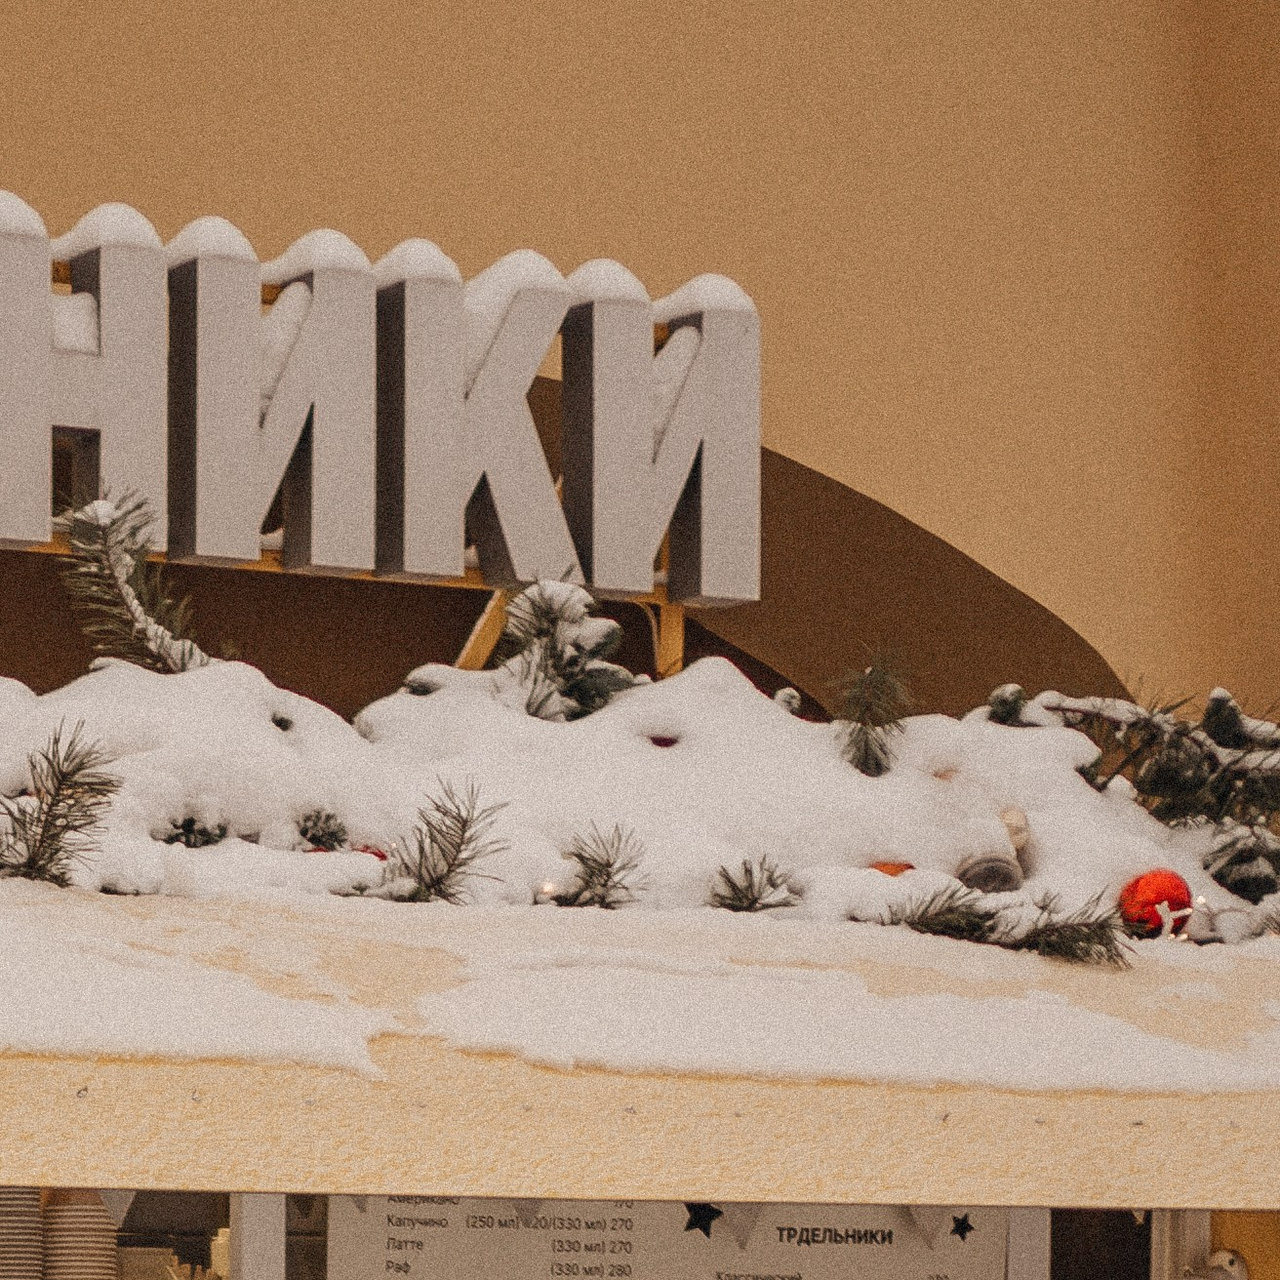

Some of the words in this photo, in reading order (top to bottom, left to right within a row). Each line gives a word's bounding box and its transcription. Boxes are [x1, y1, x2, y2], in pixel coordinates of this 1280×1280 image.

[776, 1226, 893, 1246] ТРДЕЛЬНИКИ
[386, 1237, 424, 1251] Латте
[584, 1240, 606, 1253] мл)
[609, 1240, 632, 1253] 270
[385, 1260, 411, 1275] Раф
[582, 1264, 604, 1277] мл)
